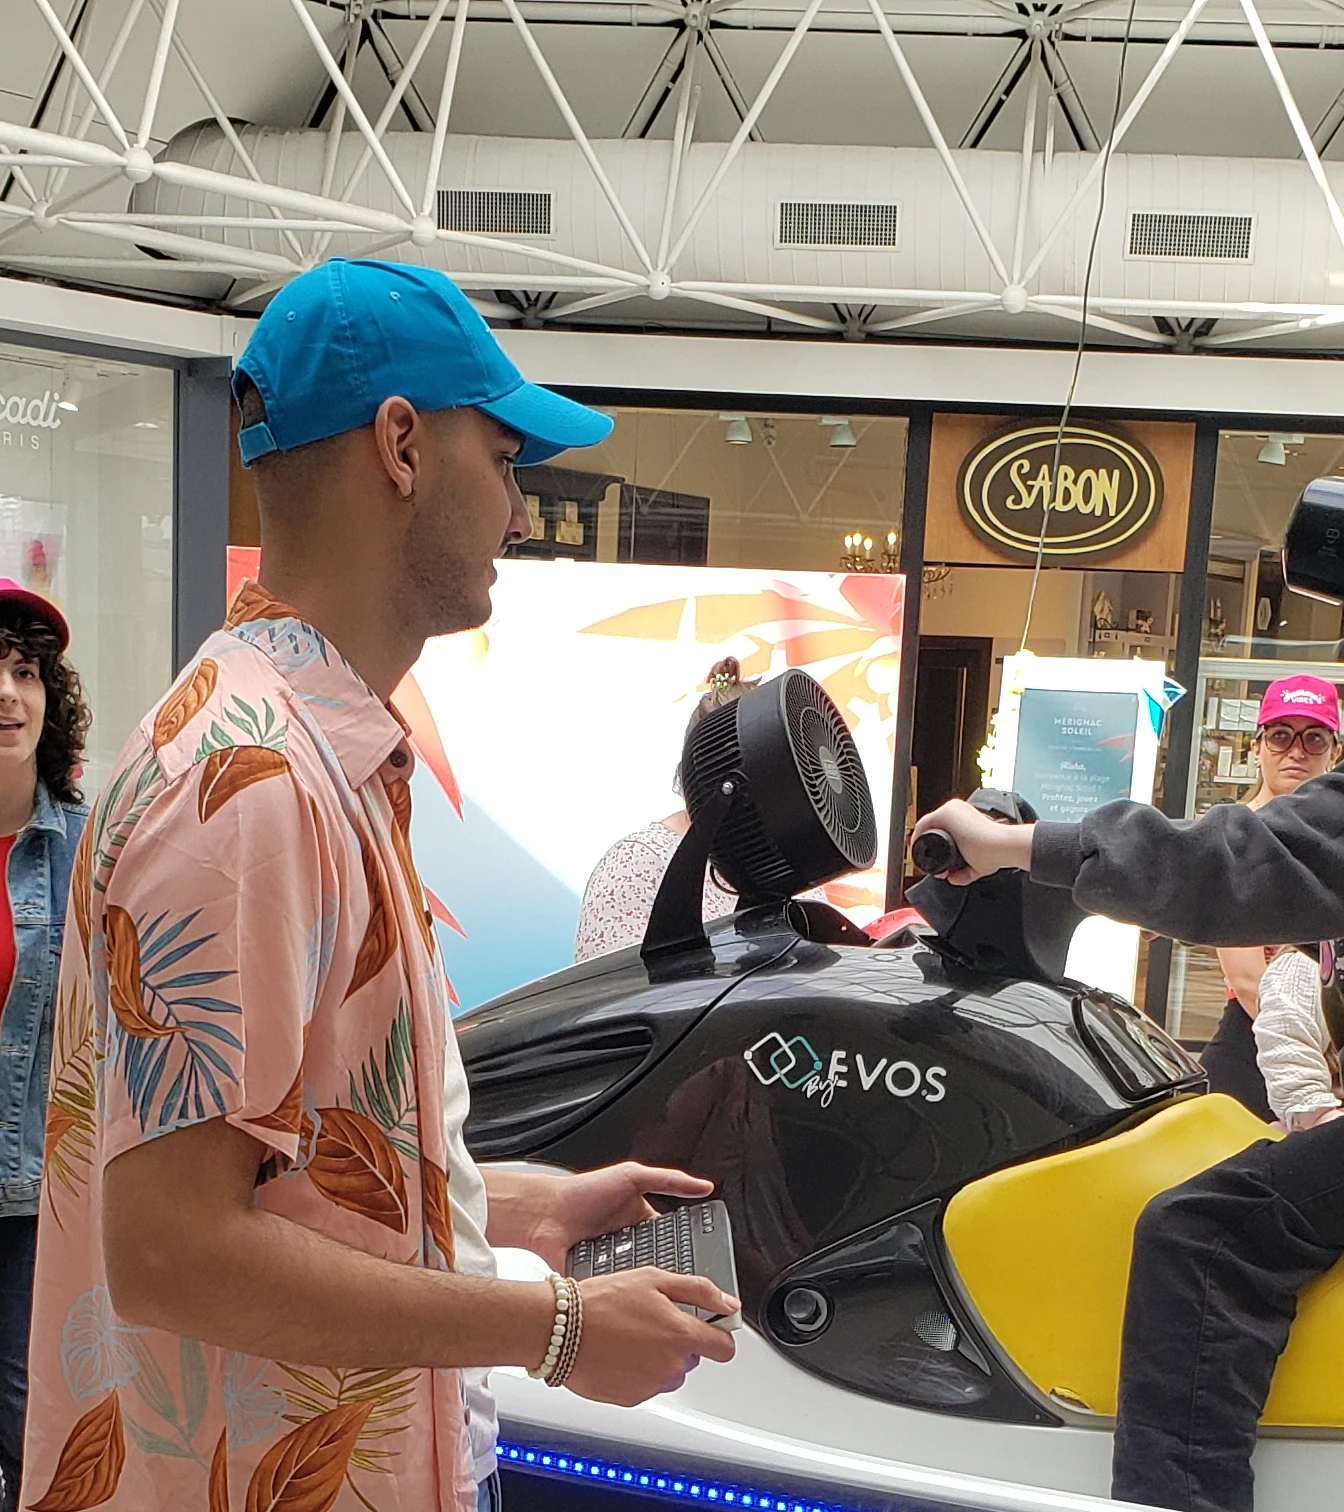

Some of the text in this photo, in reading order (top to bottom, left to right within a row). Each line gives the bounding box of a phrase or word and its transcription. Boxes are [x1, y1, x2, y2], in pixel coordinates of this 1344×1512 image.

[1006, 459, 1120, 517] SABON
[1054, 717, 1103, 727] MÉRIGNAC
[1061, 727, 1092, 736] SOLEIL
[1090, 775, 1110, 784] plage
[1049, 804, 1058, 812] et
